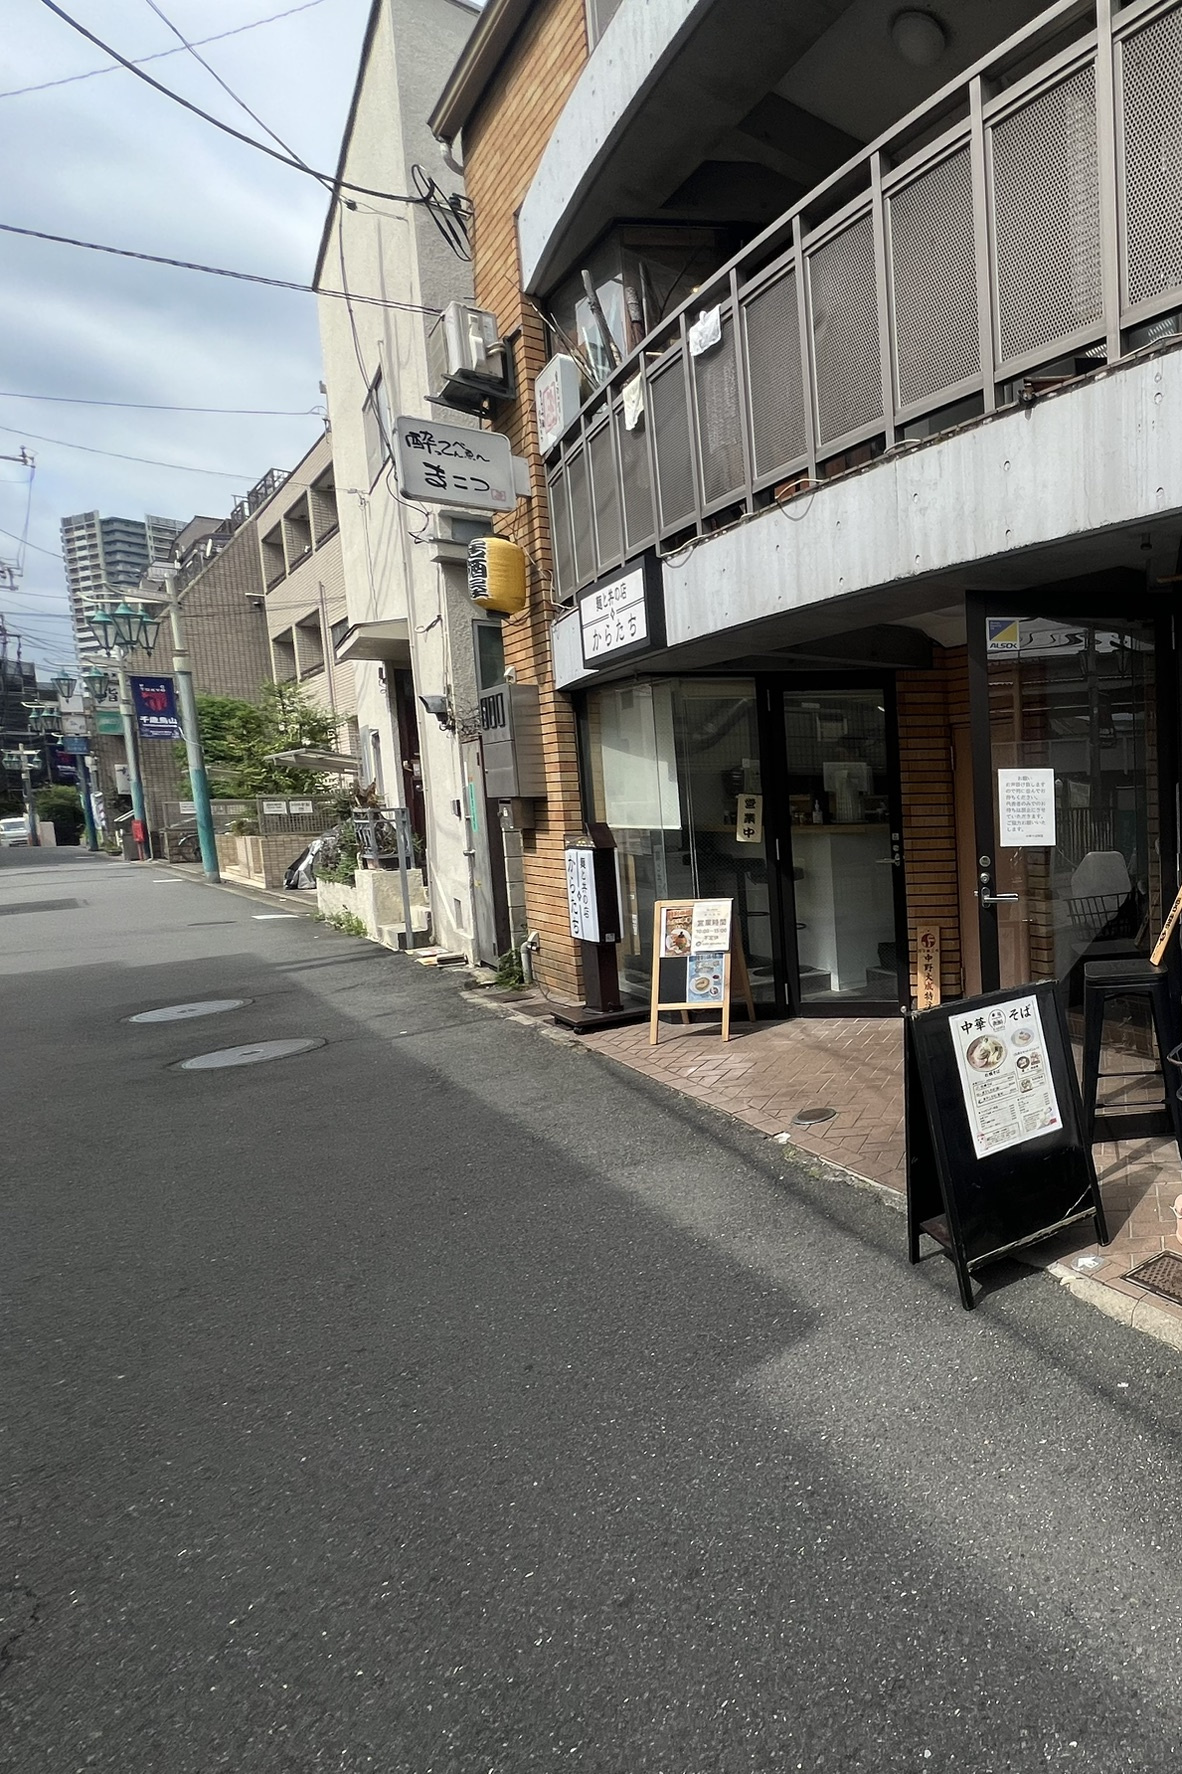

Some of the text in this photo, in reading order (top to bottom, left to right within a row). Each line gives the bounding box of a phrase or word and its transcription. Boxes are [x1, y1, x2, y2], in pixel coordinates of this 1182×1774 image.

[592, 613, 637, 652] からたち
[990, 642, 1017, 650] ALSOK
[743, 798, 757, 839] 営業中
[567, 855, 580, 935] からたち
[960, 1016, 986, 1035] 中華
[1009, 1003, 1031, 1021] そば
